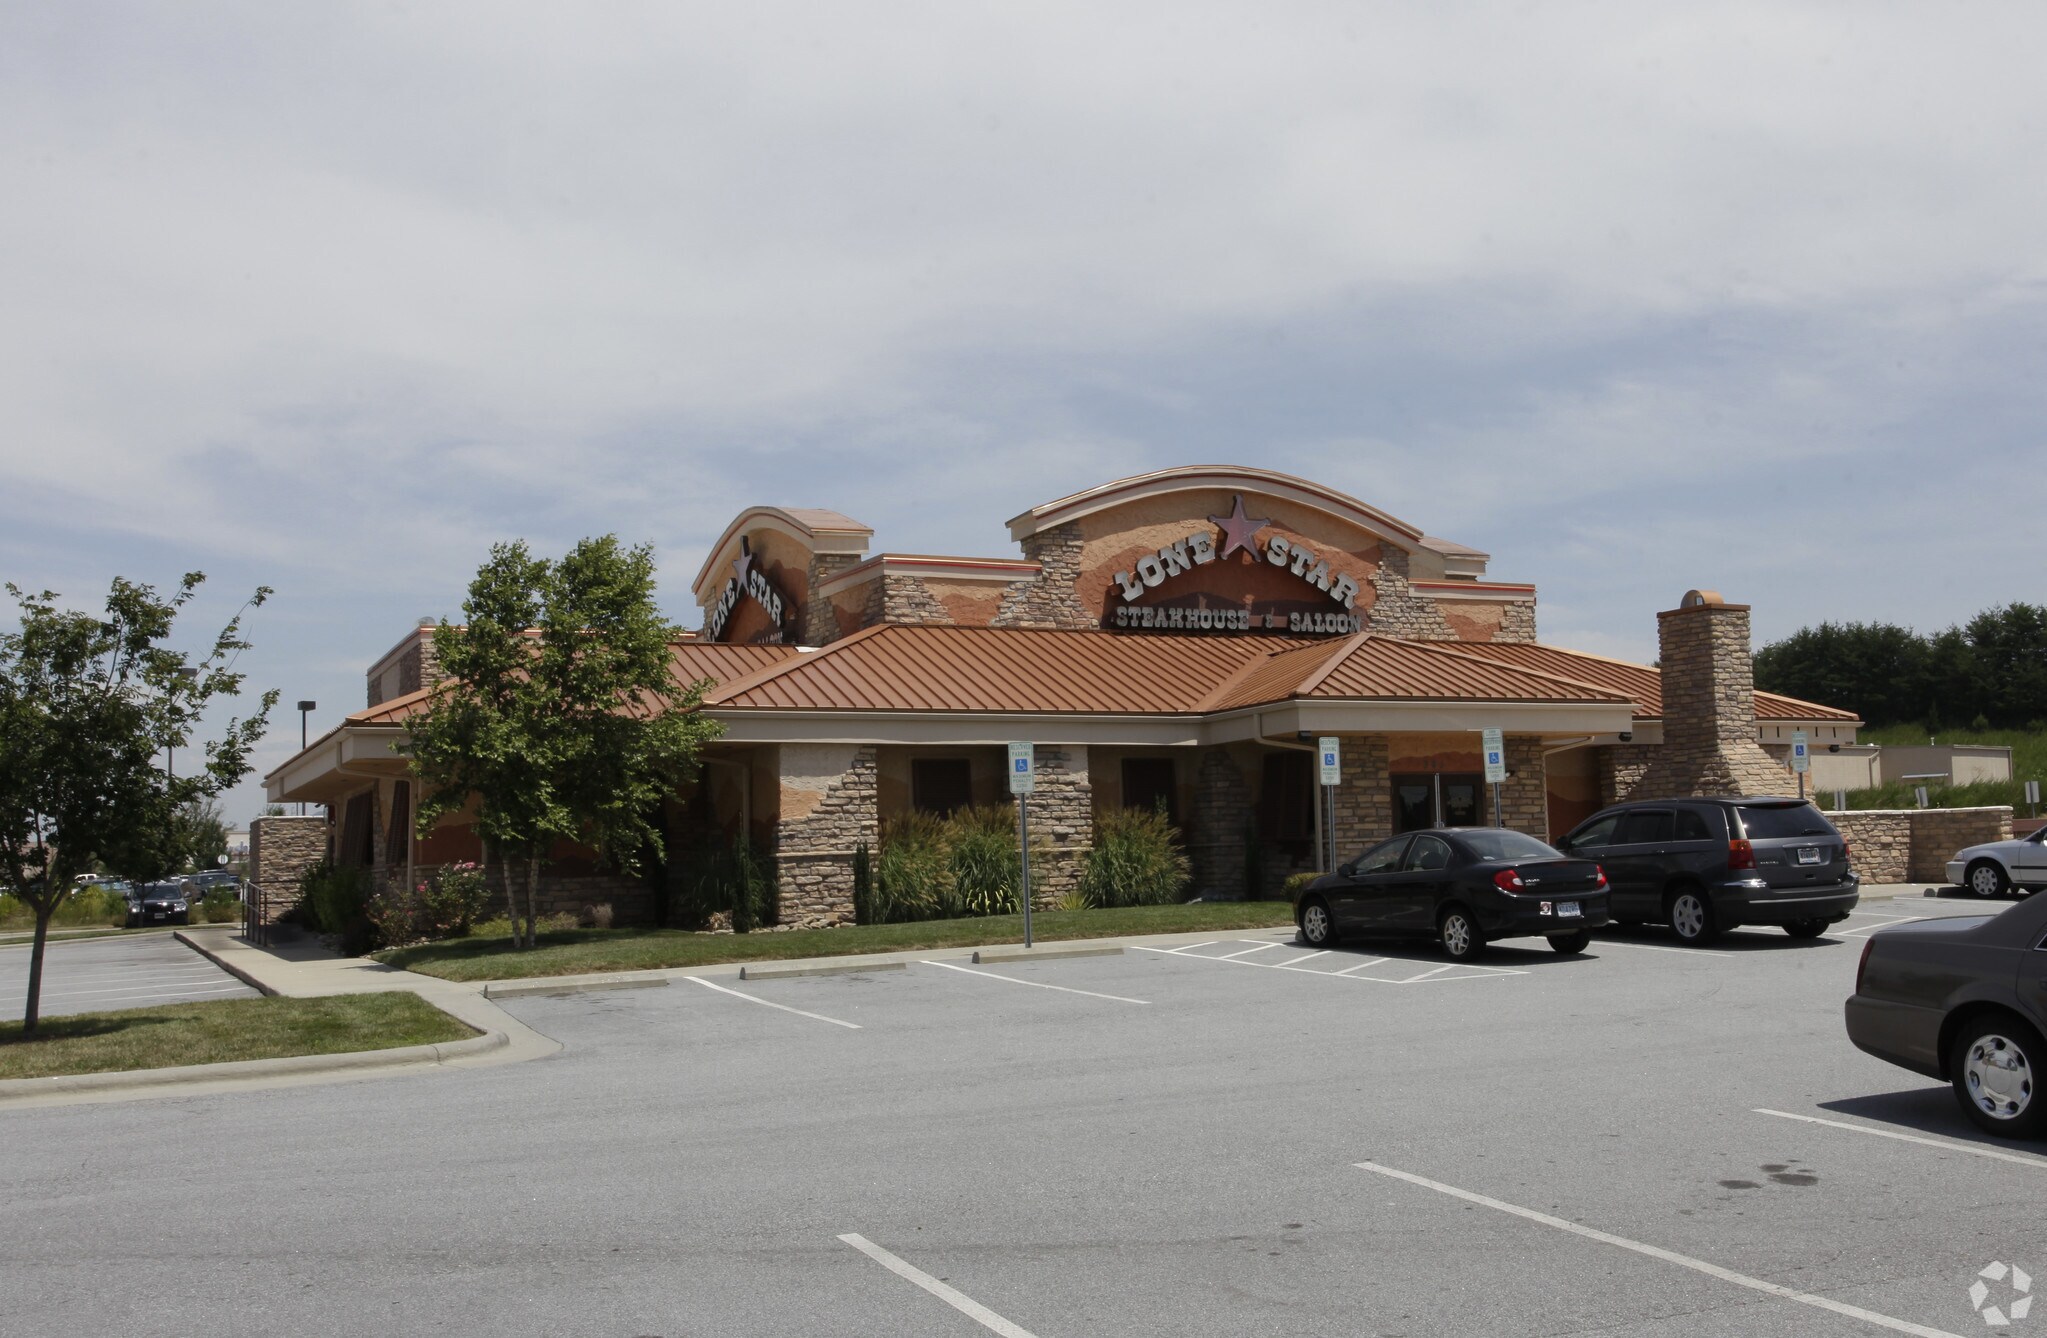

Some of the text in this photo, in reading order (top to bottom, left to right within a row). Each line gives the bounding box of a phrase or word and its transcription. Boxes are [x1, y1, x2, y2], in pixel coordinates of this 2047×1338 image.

[750, 570, 782, 627] STAR
[1114, 531, 1359, 609] LONE STAR
[1116, 606, 1250, 631] STEAKHOUSE
[1290, 612, 1362, 633] SALOON
